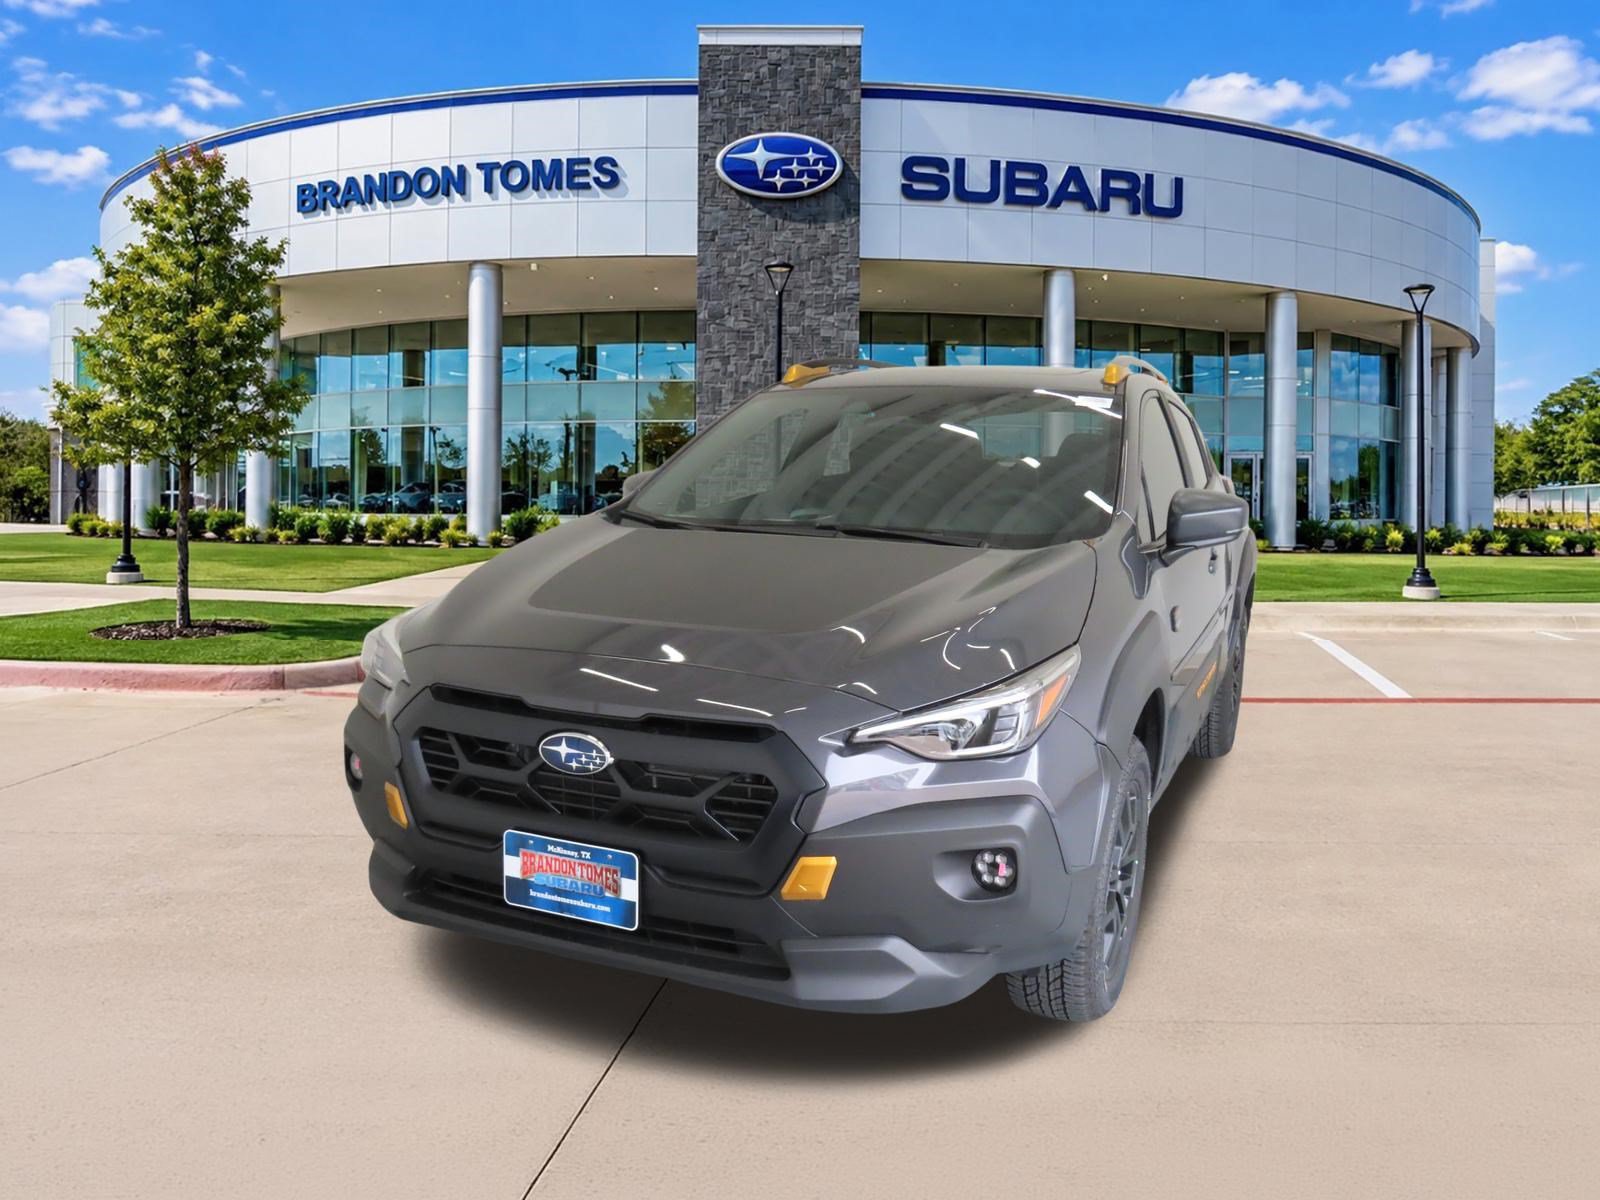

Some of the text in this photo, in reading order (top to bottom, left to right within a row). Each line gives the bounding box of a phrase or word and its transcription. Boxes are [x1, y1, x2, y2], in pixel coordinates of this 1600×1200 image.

[297, 156, 620, 213] BRANDON TOMES
[901, 155, 1184, 218] SUBARU
[520, 849, 621, 897] BRANDON TOMES
[580, 850, 591, 860] TX
[533, 874, 605, 897] SUBARU
